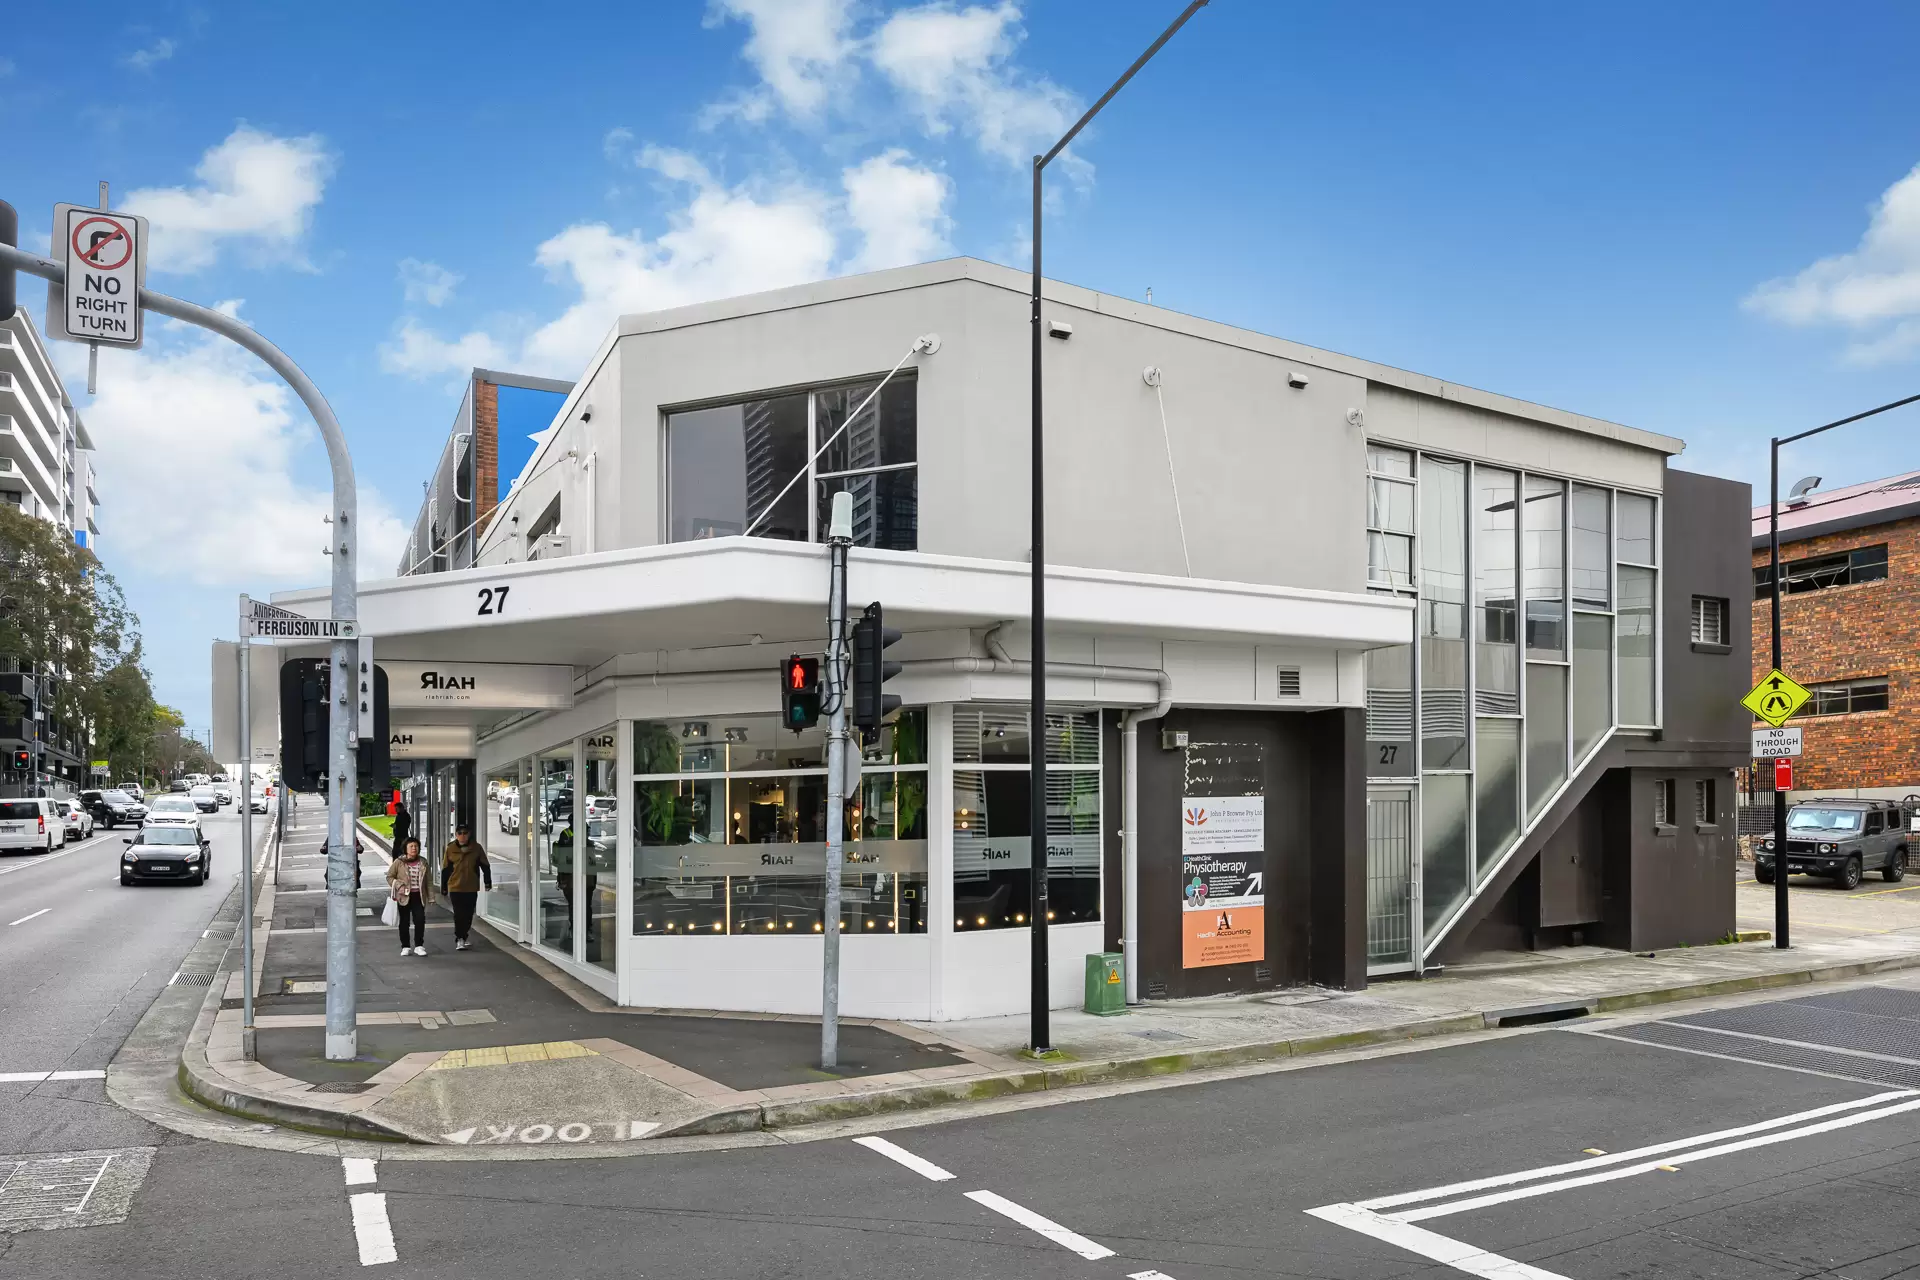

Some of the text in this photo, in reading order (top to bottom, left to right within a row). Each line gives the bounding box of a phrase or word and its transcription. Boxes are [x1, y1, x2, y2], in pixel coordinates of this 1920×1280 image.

[84, 273, 121, 295] NO
[76, 296, 128, 314] RIGHT
[78, 314, 126, 332] TURN
[477, 585, 510, 616] 27
[257, 620, 339, 637] FERGUSON LN
[390, 734, 413, 744] AH
[1755, 737, 1799, 748] THROUGH
[1769, 730, 1784, 738] NO
[1379, 744, 1398, 765] 27
[1762, 747, 1791, 756] ROAD
[1183, 860, 1247, 876] Physiotherapy
[1216, 929, 1251, 937] Accounting
[475, 1122, 628, 1145] LOOK
